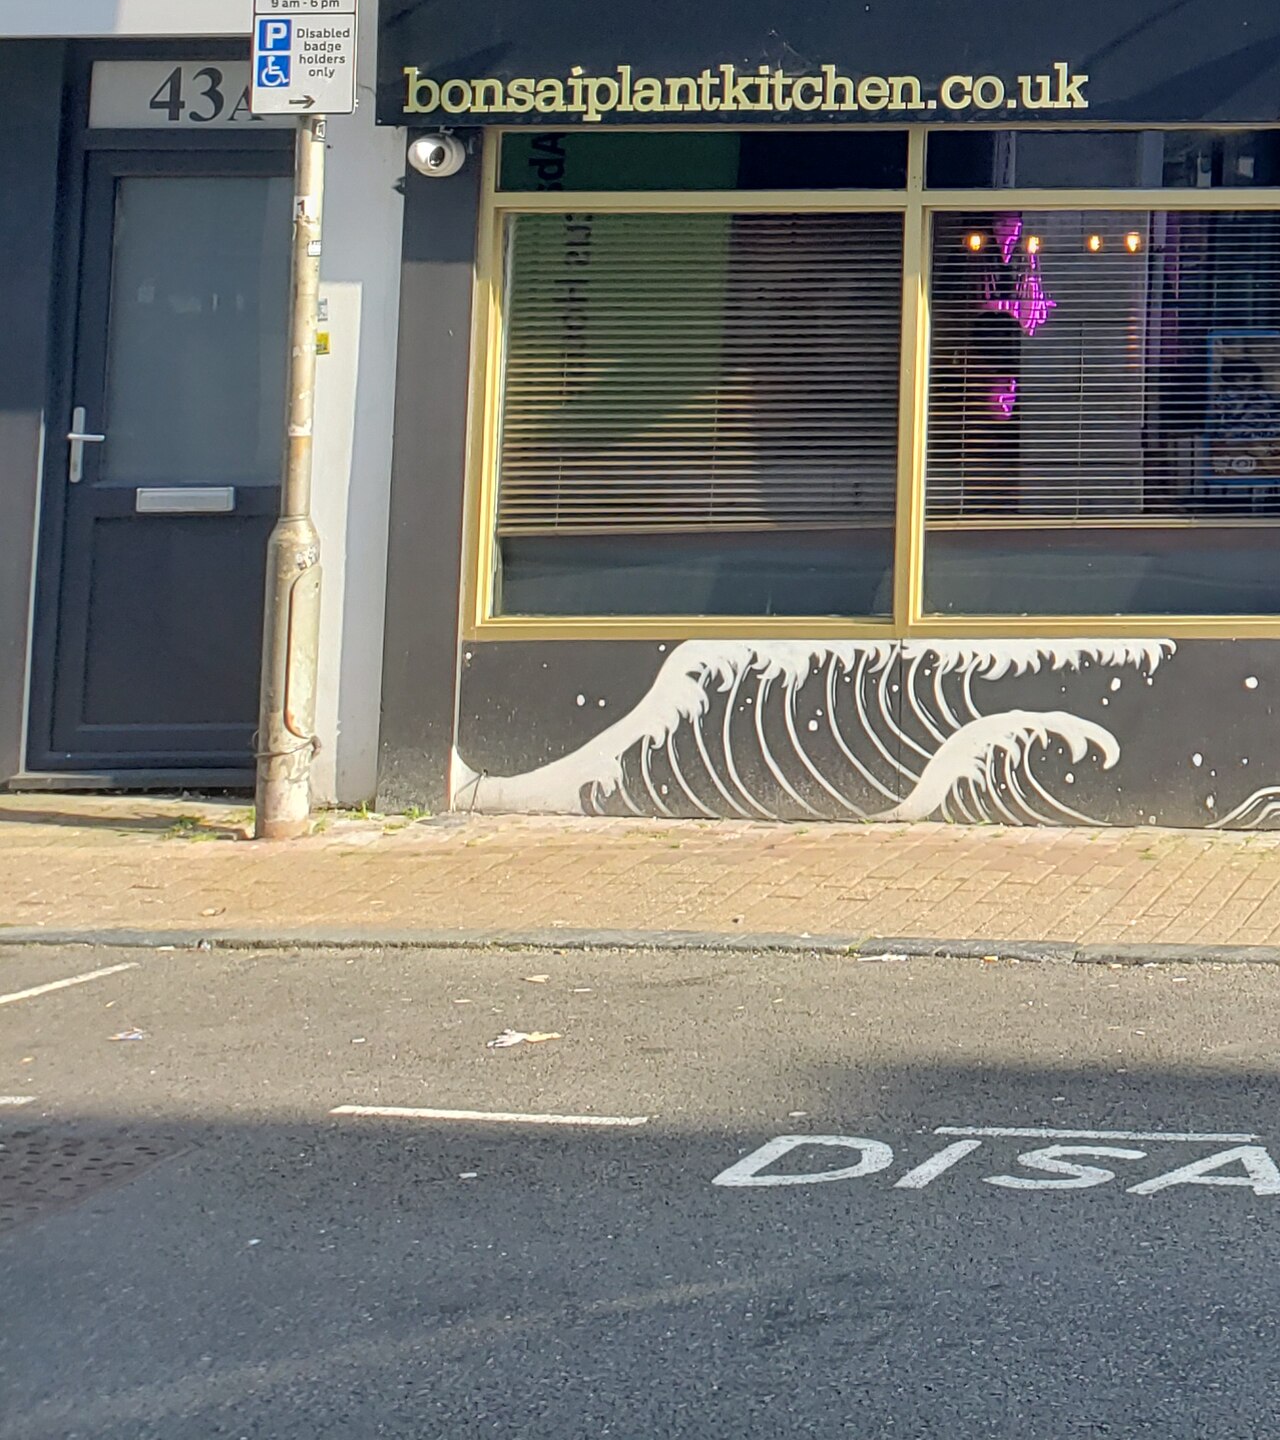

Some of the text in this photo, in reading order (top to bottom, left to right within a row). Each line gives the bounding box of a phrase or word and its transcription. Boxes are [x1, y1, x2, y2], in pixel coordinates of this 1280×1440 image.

[282, 0, 299, 8] am
[321, 0, 340, 9] pm
[297, 28, 350, 38] Disabled
[304, 41, 341, 53] badge
[299, 54, 345, 64] holders
[309, 67, 335, 78] only
[402, 62, 1089, 121] bonsaiplantkitchen.co.uk
